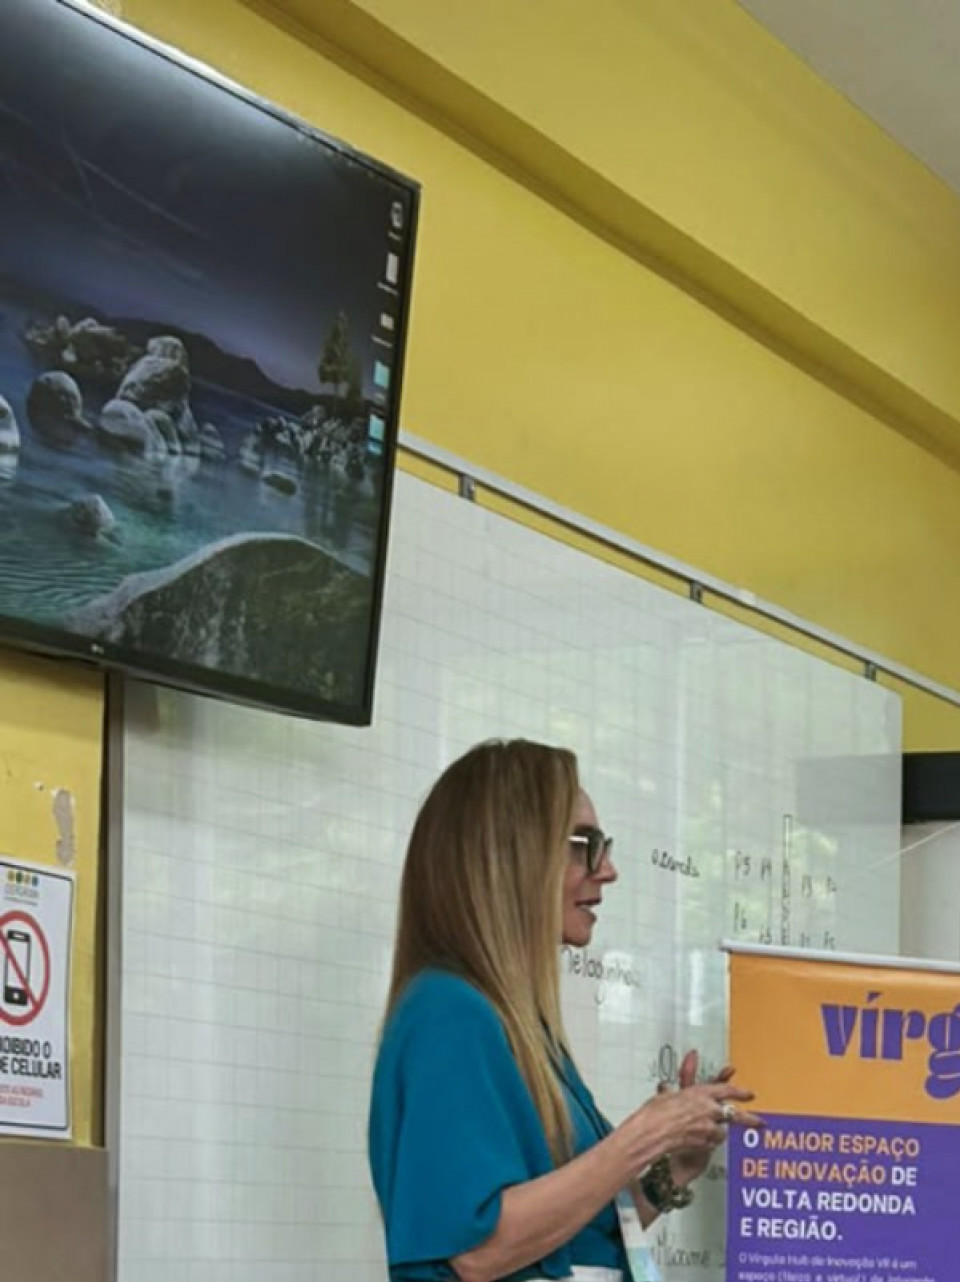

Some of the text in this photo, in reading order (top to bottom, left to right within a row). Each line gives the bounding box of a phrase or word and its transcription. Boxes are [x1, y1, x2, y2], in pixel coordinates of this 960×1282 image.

[0, 1034, 51, 1059] OIBIDO O
[11, 1056, 62, 1080] CELULAR
[743, 1128, 920, 1162] O MAIOR ESPAÇO
[742, 1158, 769, 1178] DE
[774, 1159, 887, 1188] INOVAÇÃO
[891, 1166, 918, 1186] DE
[741, 1187, 916, 1216] VOLTA REDONDA
[740, 1216, 843, 1241] E REGIÃO.
